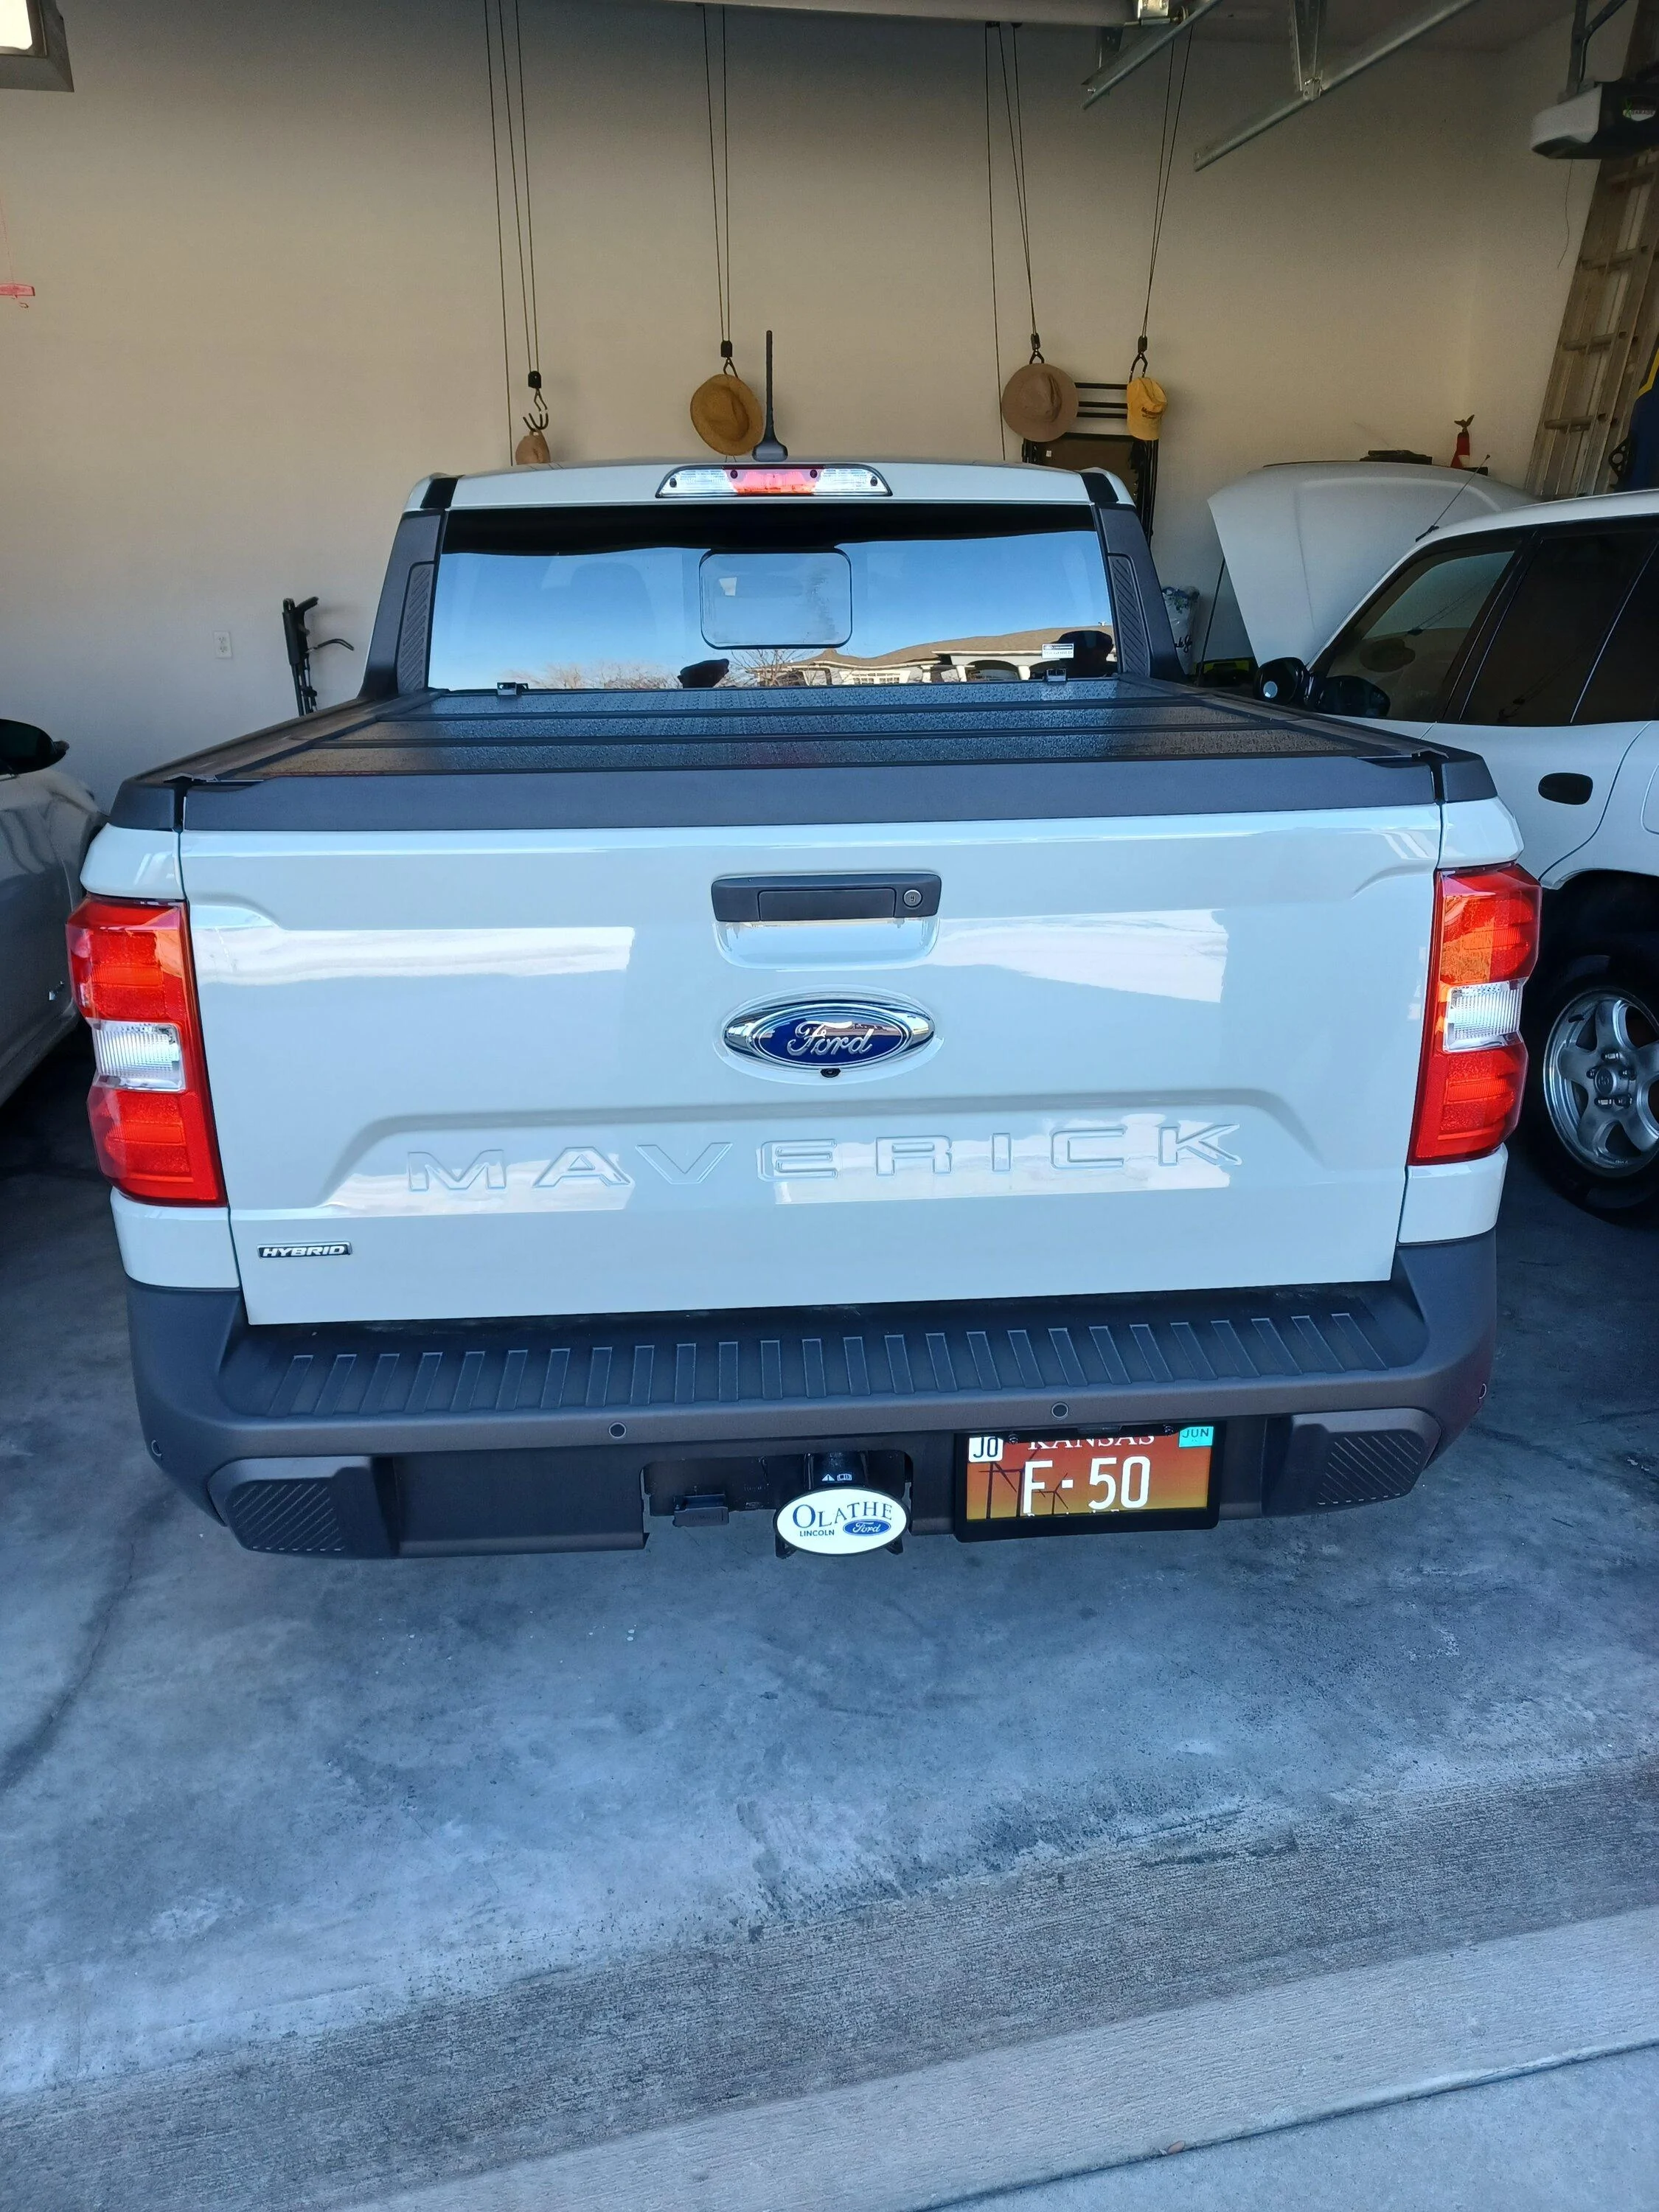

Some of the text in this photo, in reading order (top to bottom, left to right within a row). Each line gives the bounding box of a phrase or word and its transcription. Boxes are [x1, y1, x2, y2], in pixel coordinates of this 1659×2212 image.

[787, 1020, 875, 1056] Ford
[407, 1124, 1241, 1192] MAVERICK
[262, 1245, 345, 1257] HYBRID
[1183, 1427, 1209, 1438] JUN
[799, 1529, 835, 1537] LINCOLN
[852, 1521, 881, 1534] Ford
